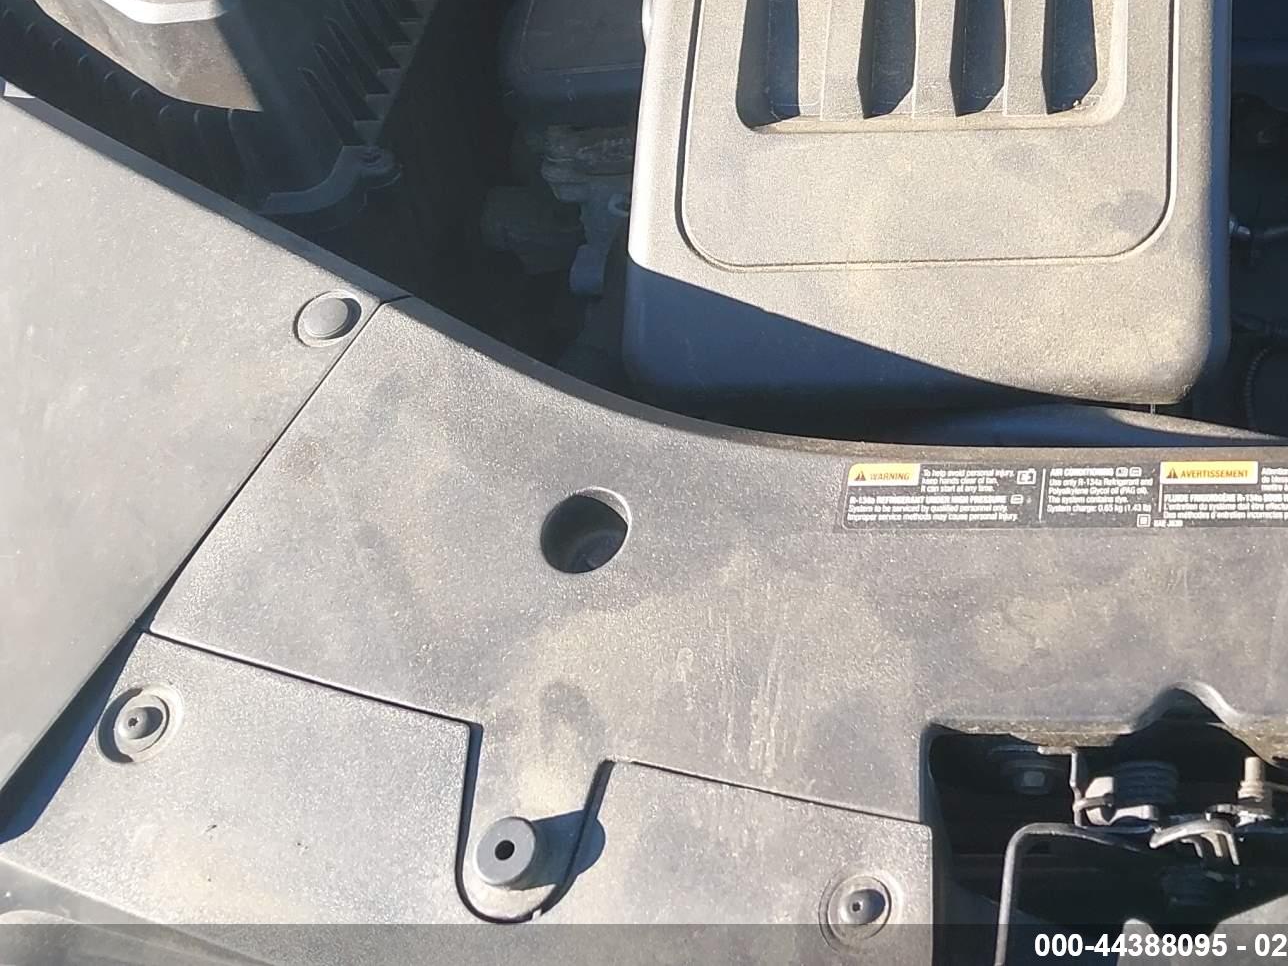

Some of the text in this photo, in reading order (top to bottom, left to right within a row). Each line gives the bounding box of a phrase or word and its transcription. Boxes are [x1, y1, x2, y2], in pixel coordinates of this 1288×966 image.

[966, 469, 994, 478] personal
[1050, 468, 1063, 476] AIR
[848, 504, 873, 513] System
[922, 504, 929, 513] by
[931, 504, 958, 513] qualified
[959, 504, 992, 513] personnel
[1047, 505, 1071, 514] System
[969, 513, 997, 522] personal
